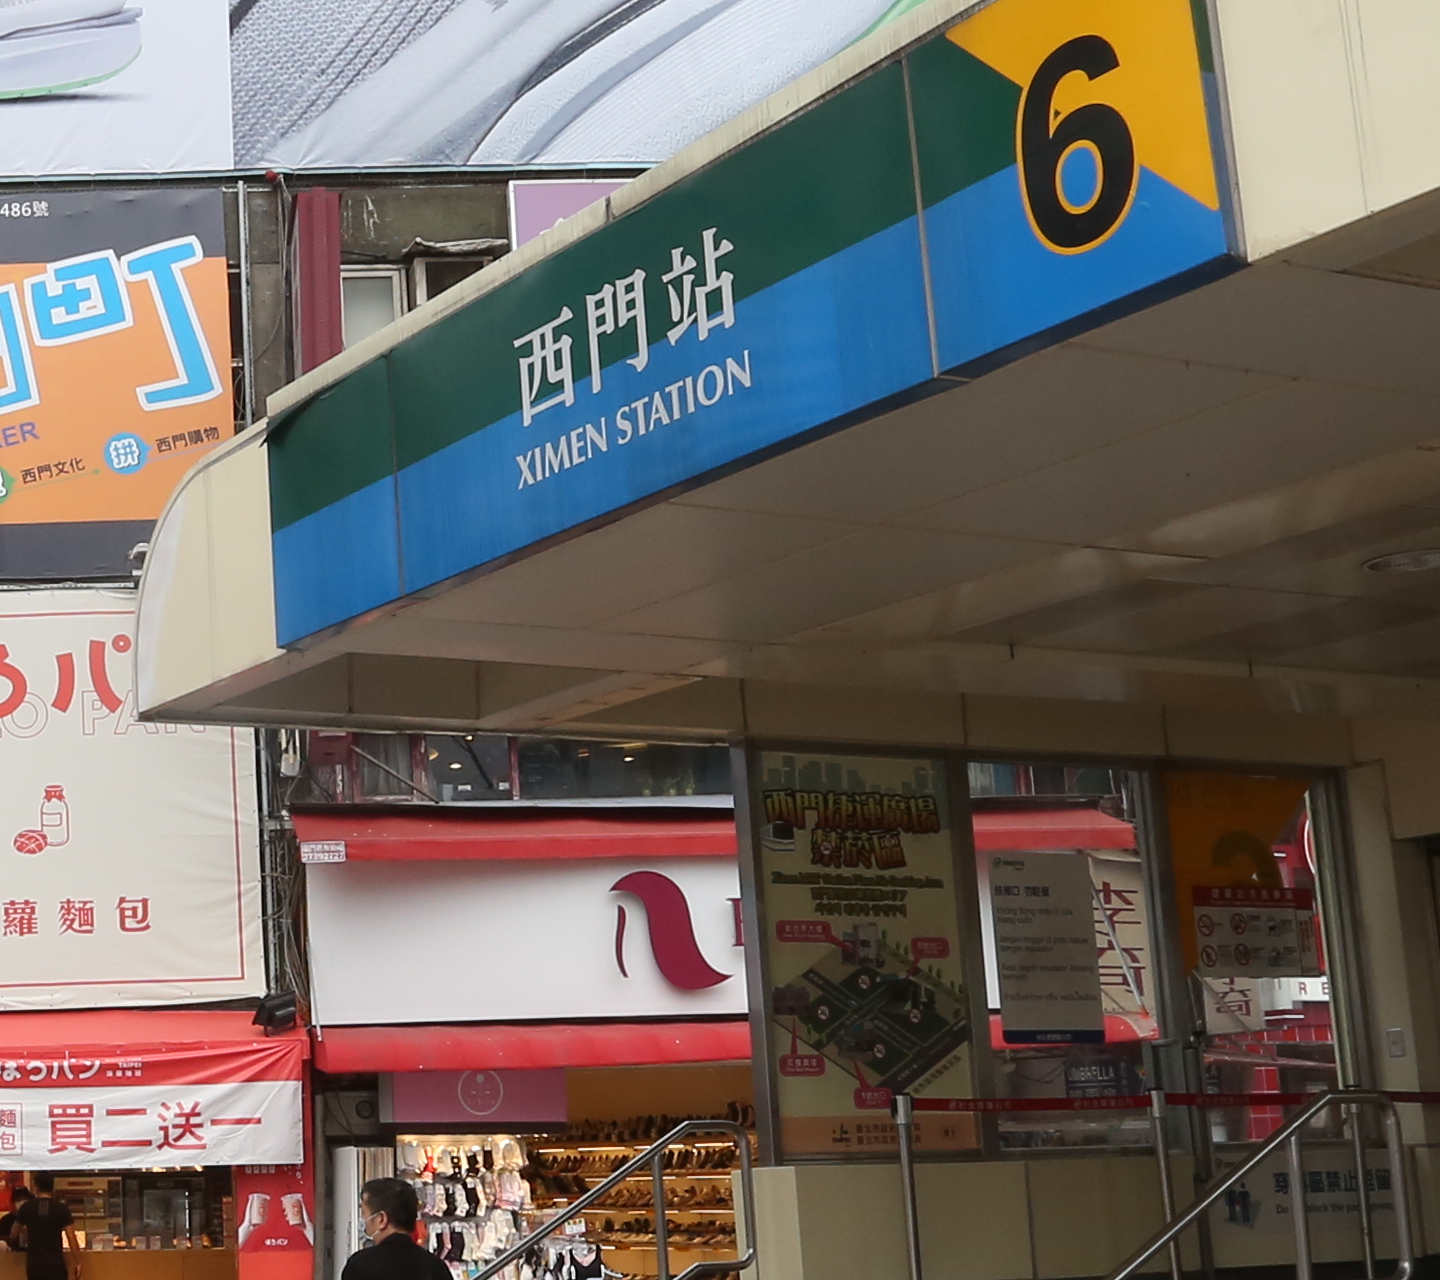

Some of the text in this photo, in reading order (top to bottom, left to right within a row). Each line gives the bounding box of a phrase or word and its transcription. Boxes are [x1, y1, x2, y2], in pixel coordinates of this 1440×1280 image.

[1017, 33, 1139, 253] 6
[513, 226, 737, 428] 西門站
[515, 348, 754, 489] XIMEN STATION
[110, 425, 220, 468] 拼 西門購物
[19, 457, 85, 485] 西門文化
[763, 790, 940, 833] 西門捷運廣場
[47, 1100, 263, 1154] 買二送一
[1273, 1169, 1391, 1194] 穿區禁止留
